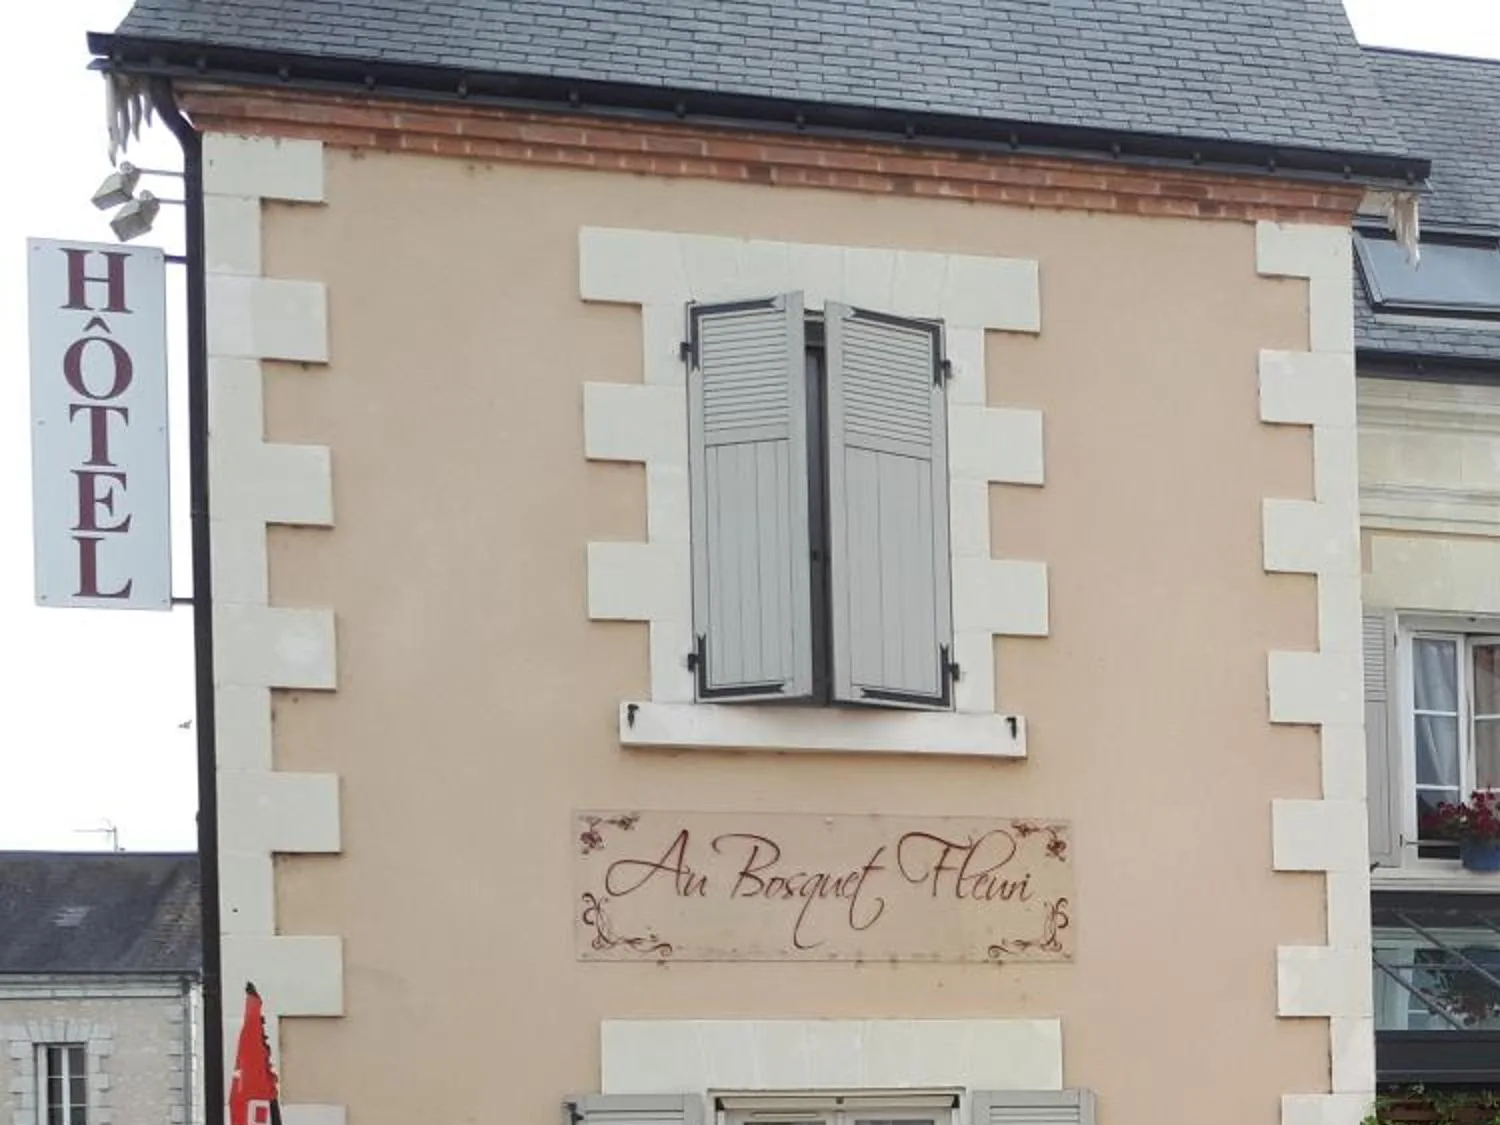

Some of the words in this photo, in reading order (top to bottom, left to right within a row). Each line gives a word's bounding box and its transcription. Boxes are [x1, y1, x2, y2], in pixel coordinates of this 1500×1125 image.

[59, 246, 135, 600] HÔTEL
[605, 829, 708, 897] Au
[711, 832, 888, 950] Bosquet
[896, 829, 1038, 901] Fleuri
